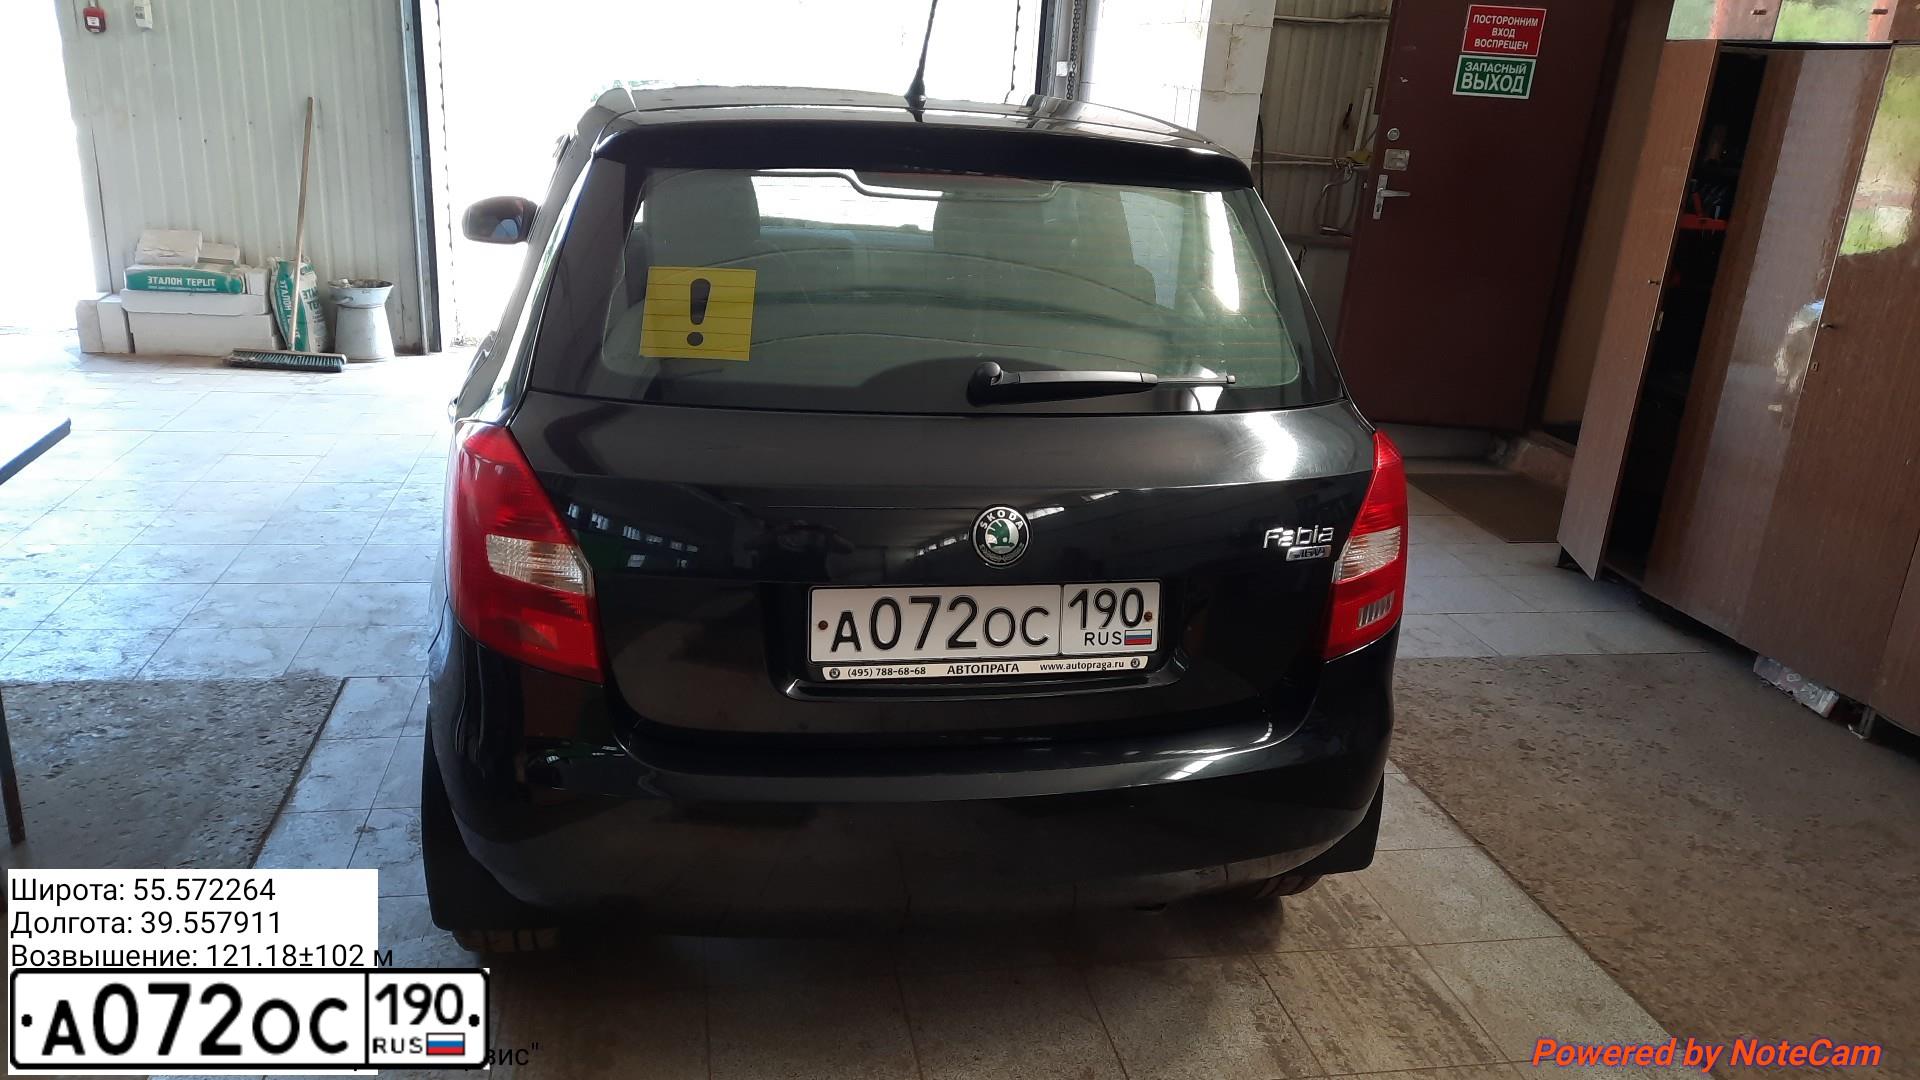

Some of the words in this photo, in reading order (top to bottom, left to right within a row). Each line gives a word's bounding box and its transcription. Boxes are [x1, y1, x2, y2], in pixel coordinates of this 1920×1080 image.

[1473, 14, 1539, 27] ПОСТОРОННИМ
[1491, 27, 1516, 39] ВХОД
[1474, 38, 1529, 51] ВОСПРЕЩЕН
[1464, 61, 1527, 75] ЗАПАСНЫЙ
[1460, 72, 1525, 94] ВЫХОД
[147, 275, 183, 286] ЭТАЛОН
[979, 509, 1024, 530] SKODA
[1263, 524, 1335, 549] Fabia
[1068, 587, 1146, 630] 190
[1084, 631, 1122, 647] RUS
[847, 668, 873, 678] (495)
[876, 666, 926, 677] 788-68-68
[946, 663, 1020, 676] АВТОПРАГА
[1039, 661, 1125, 672] www.autopraga.ru
